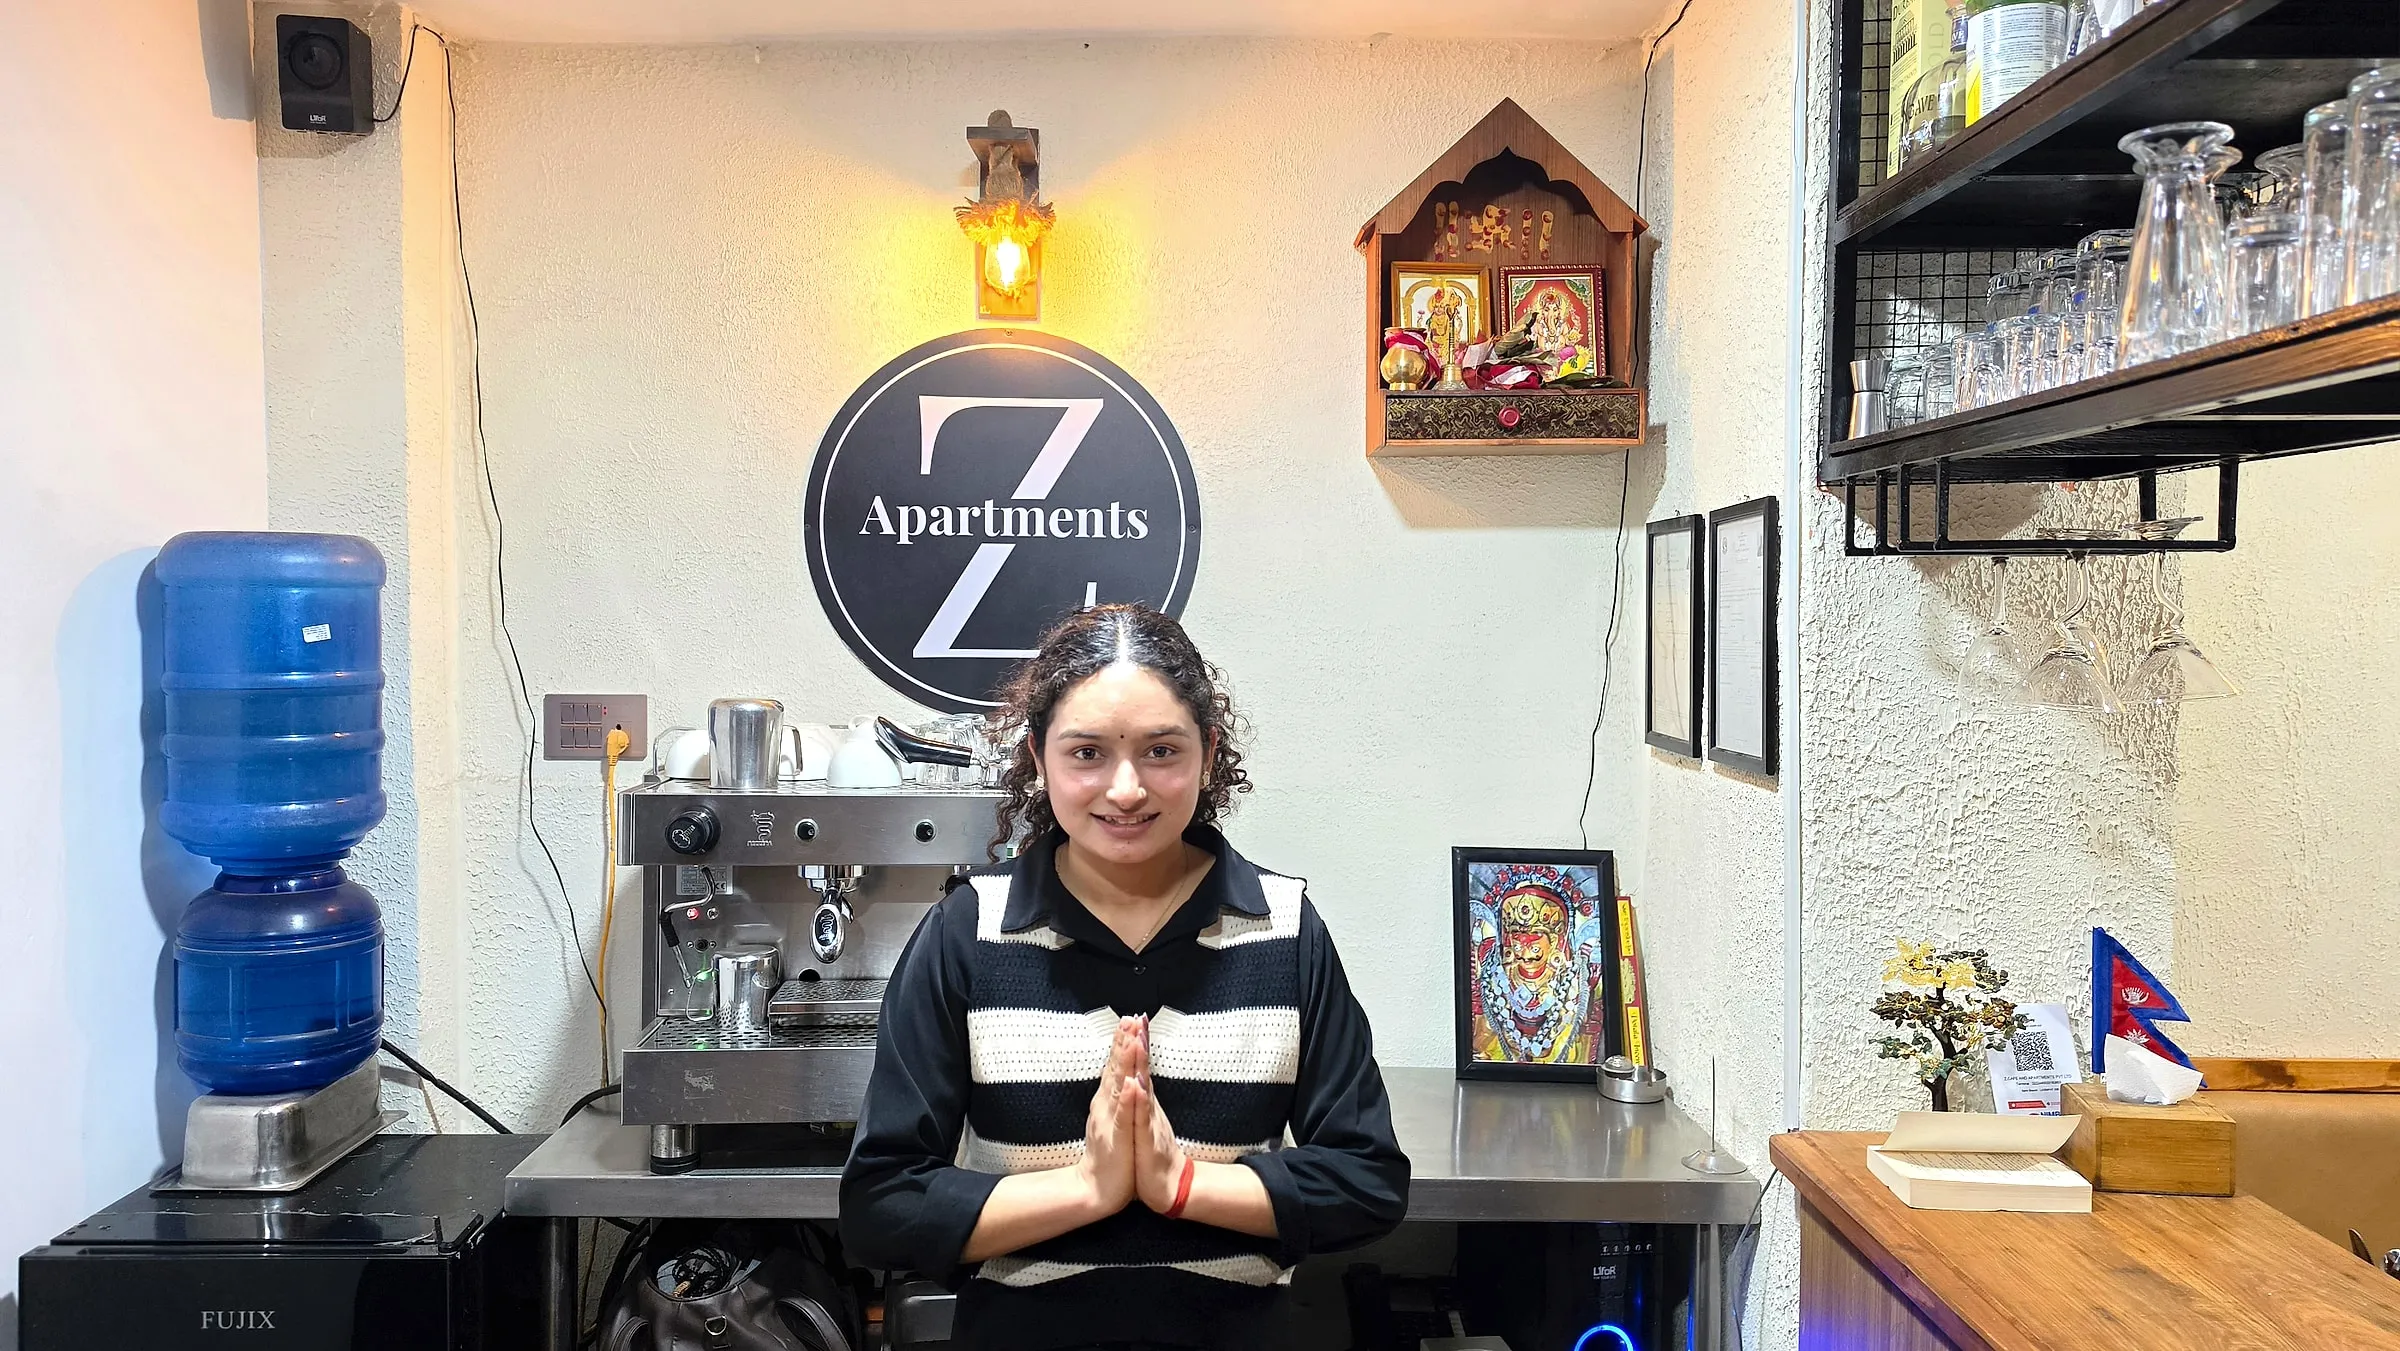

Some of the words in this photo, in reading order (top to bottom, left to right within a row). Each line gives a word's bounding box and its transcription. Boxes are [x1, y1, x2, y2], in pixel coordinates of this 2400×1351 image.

[858, 495, 1150, 545] Apartments
[912, 395, 1104, 659] Z
[200, 1310, 276, 1330] FUJIX
